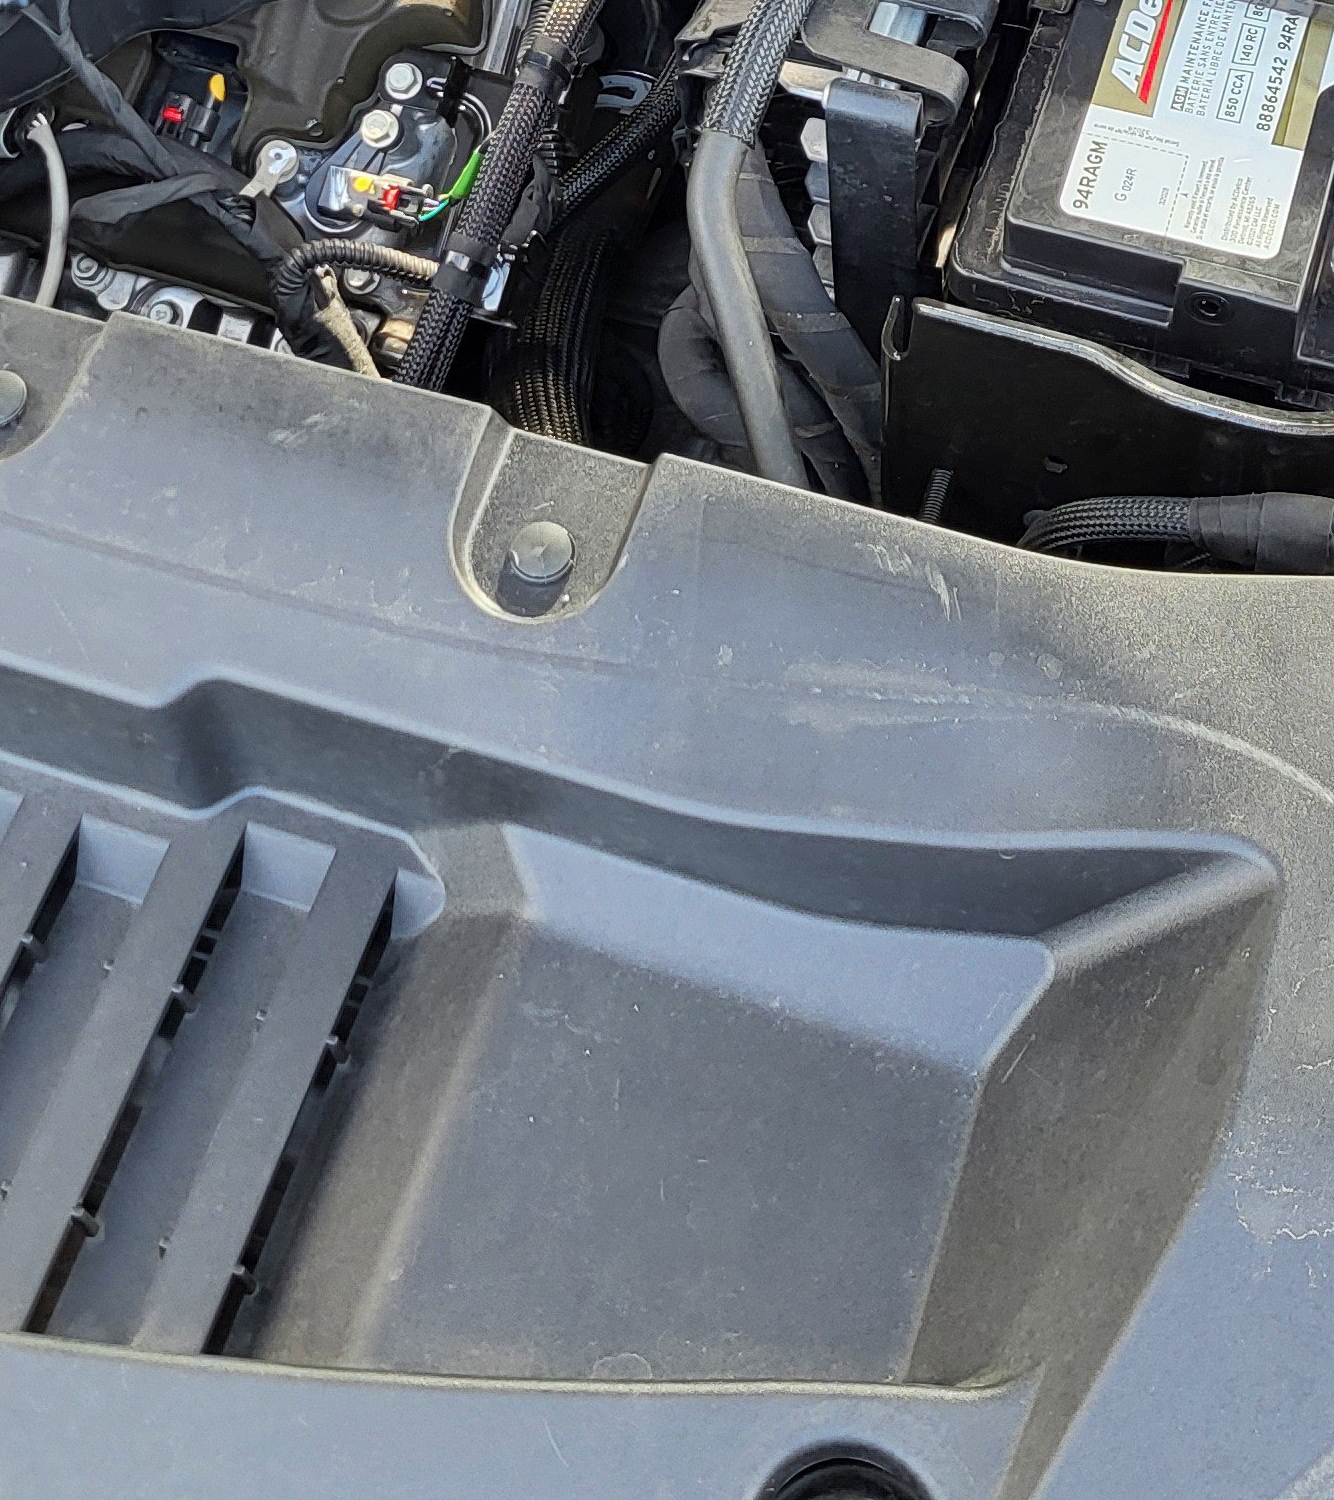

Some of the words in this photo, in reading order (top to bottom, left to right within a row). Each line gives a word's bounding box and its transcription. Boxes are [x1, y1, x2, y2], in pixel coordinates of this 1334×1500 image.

[1179, 6, 1210, 84] MAINTENANCE
[1245, 27, 1258, 42] RC
[1239, 43, 1254, 62] 140
[1184, 69, 1204, 113] BATTERIE
[1197, 43, 1211, 67] SANS
[1193, 76, 1214, 117] BATERÍA
[1207, 49, 1222, 75] LIBRE
[1215, 34, 1226, 47] DE
[1229, 71, 1246, 95] CCA
[1171, 85, 1188, 110] AGM
[1254, 55, 1289, 132] 88864542
[1223, 96, 1239, 118] 850
[1071, 137, 1108, 212] 94RAGM
[1120, 166, 1137, 192] 024R
[1241, 176, 1252, 195] Center
[1115, 191, 1129, 203] G
[1253, 205, 1262, 217] LLC
